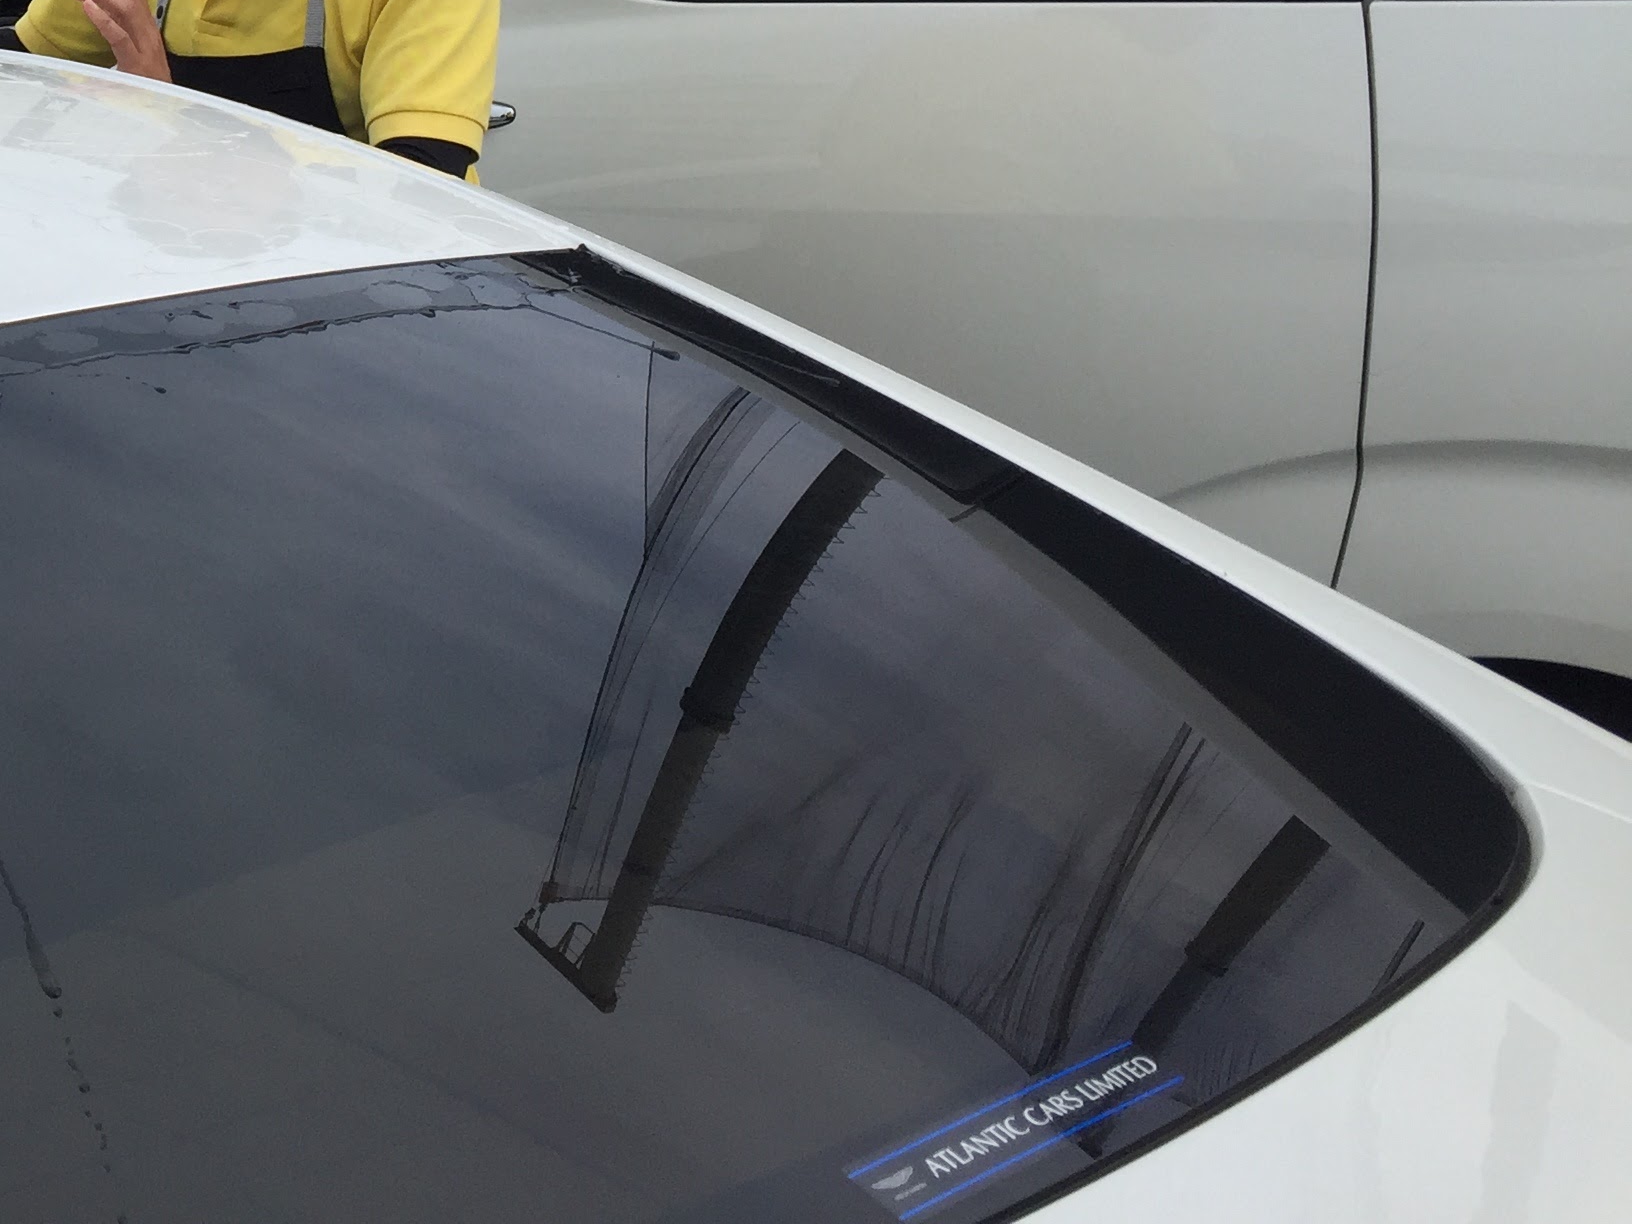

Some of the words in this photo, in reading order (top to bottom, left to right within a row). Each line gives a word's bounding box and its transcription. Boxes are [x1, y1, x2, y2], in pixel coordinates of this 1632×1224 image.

[924, 1115, 1031, 1179] ATLANTIC
[1024, 1089, 1084, 1127] CARS
[1075, 1055, 1158, 1101] LIMITED
